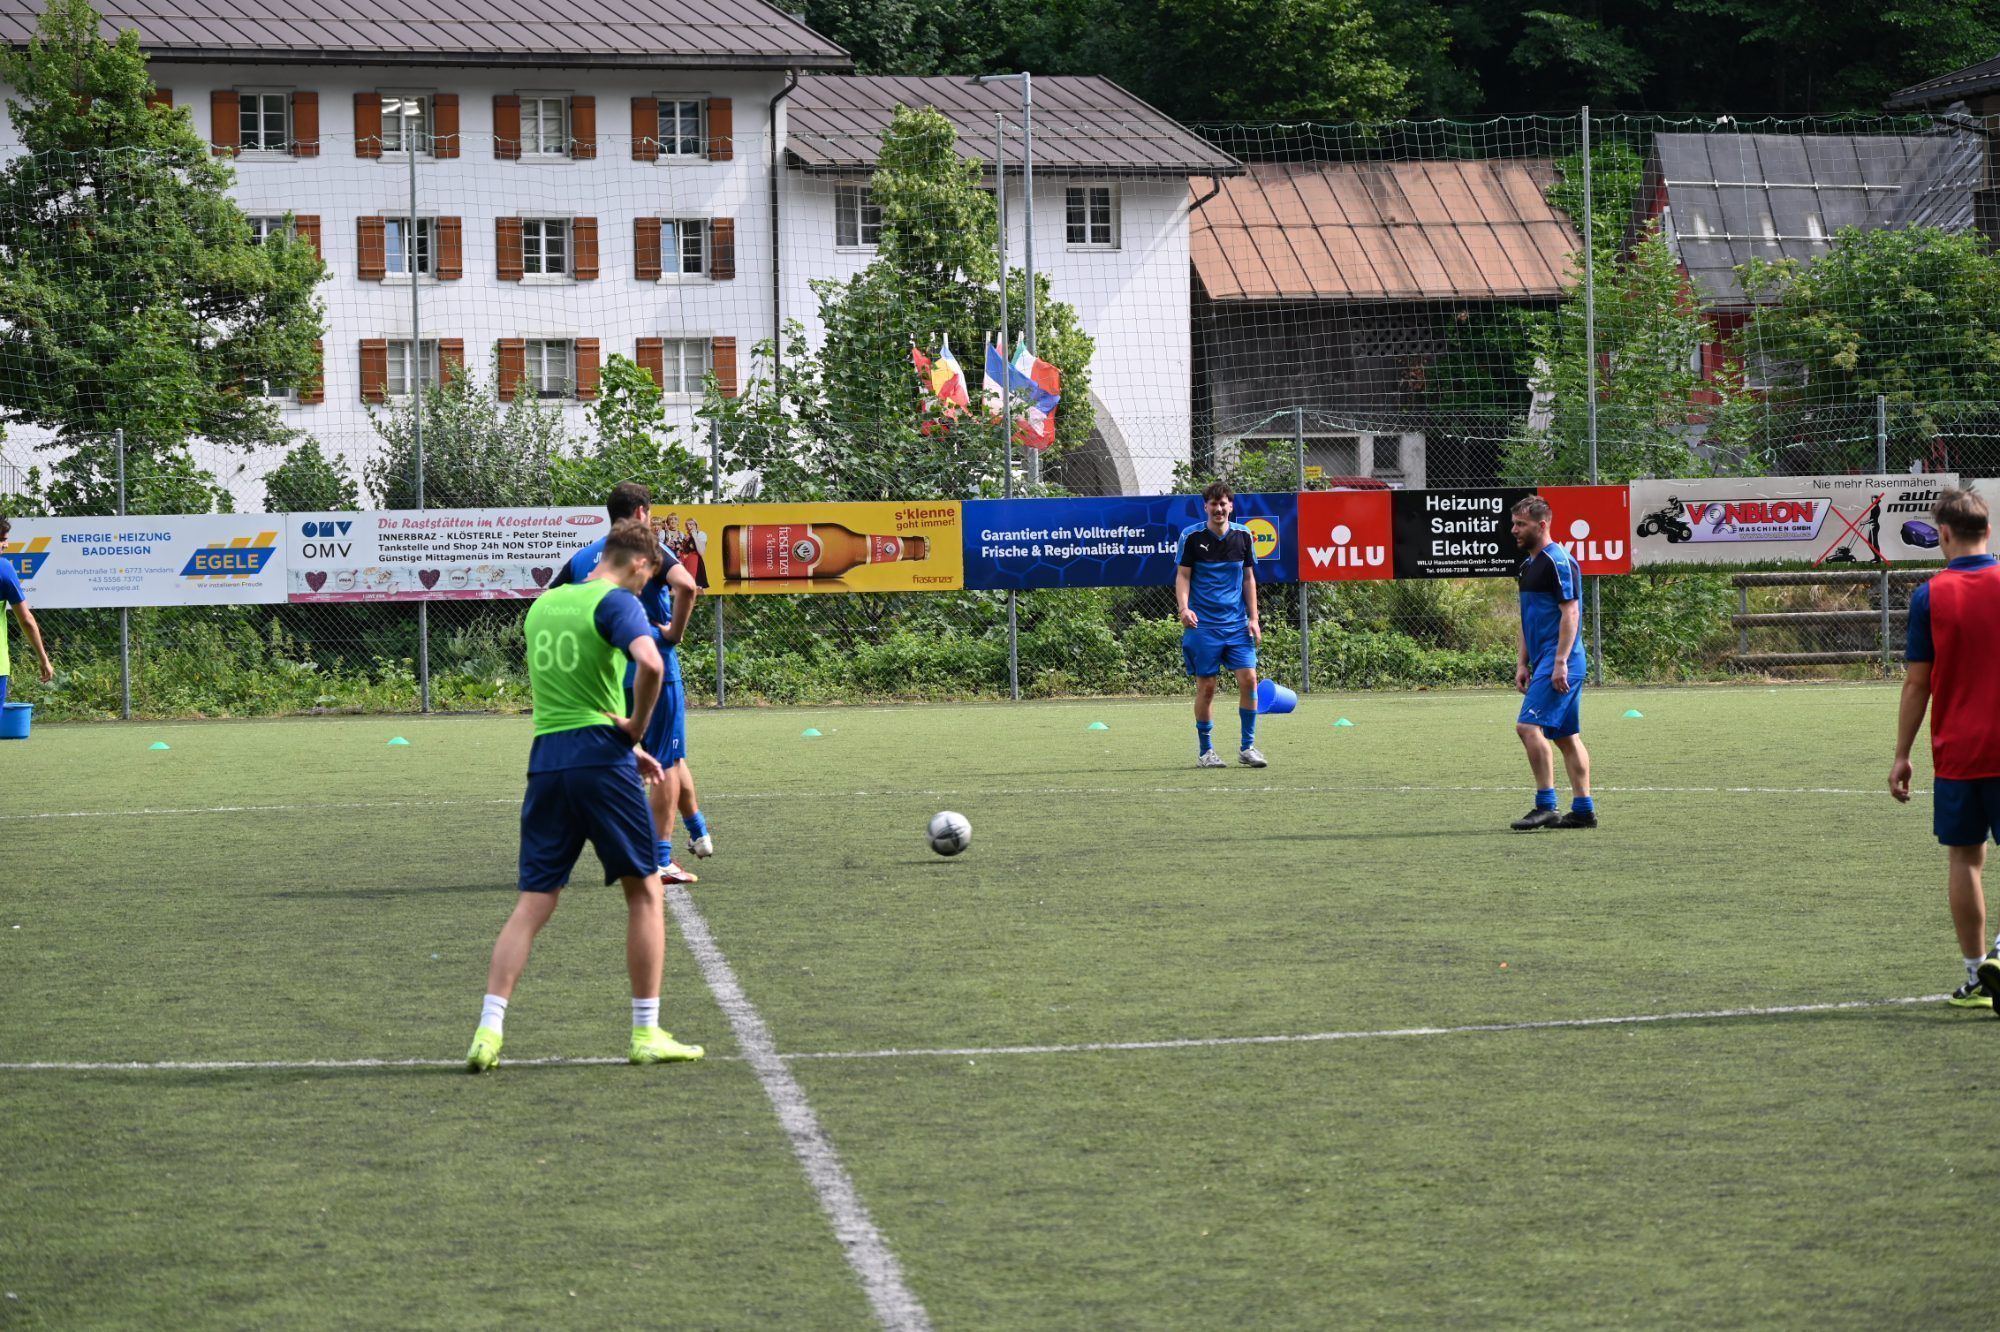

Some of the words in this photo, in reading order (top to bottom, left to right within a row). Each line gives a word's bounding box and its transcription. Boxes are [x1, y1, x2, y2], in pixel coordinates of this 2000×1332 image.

[1813, 480, 1831, 489] Nie
[1834, 479, 1862, 489] mehr
[1865, 477, 1937, 488] Rasenmähen
[1426, 494, 1503, 513] Heizung
[574, 516, 596, 524] VIVA
[1686, 501, 1813, 526] VONBLON
[378, 518, 398, 529] Die
[402, 516, 473, 529] Raststätten
[477, 516, 493, 528] im
[496, 515, 563, 527] Klostertal
[896, 520, 919, 531] goht
[921, 518, 955, 528] immer!
[1431, 517, 1499, 534] Sanitär
[61, 533, 112, 543] ENERGIE
[118, 532, 172, 542] HEIZUNG
[378, 533, 437, 541] INNERBRAZ
[447, 531, 503, 540] KLÖSTERLE
[542, 530, 577, 538] Steiner
[981, 528, 1048, 541] Garantiert
[1051, 526, 1072, 539] ein
[1074, 526, 1145, 539] Volltreffer:
[82, 546, 151, 556] BADDESIGN
[303, 543, 352, 558] OMV
[378, 543, 429, 551] Tankstelle
[432, 543, 450, 551] und
[453, 542, 478, 552] Shop
[481, 541, 499, 550] 24h
[503, 542, 525, 550] NON
[527, 541, 553, 549] STOP
[981, 545, 1029, 558] Frische
[1031, 544, 1042, 556] &
[1044, 543, 1125, 558] Regionalität
[1128, 545, 1155, 554] zum
[1432, 540, 1499, 556] Elektro
[195, 554, 260, 570] EGELE
[378, 554, 422, 563] Günstige
[425, 552, 489, 563] Mittagmenüs
[491, 552, 504, 560] im
[507, 551, 561, 560] Restaurant
[534, 629, 579, 672] 80
